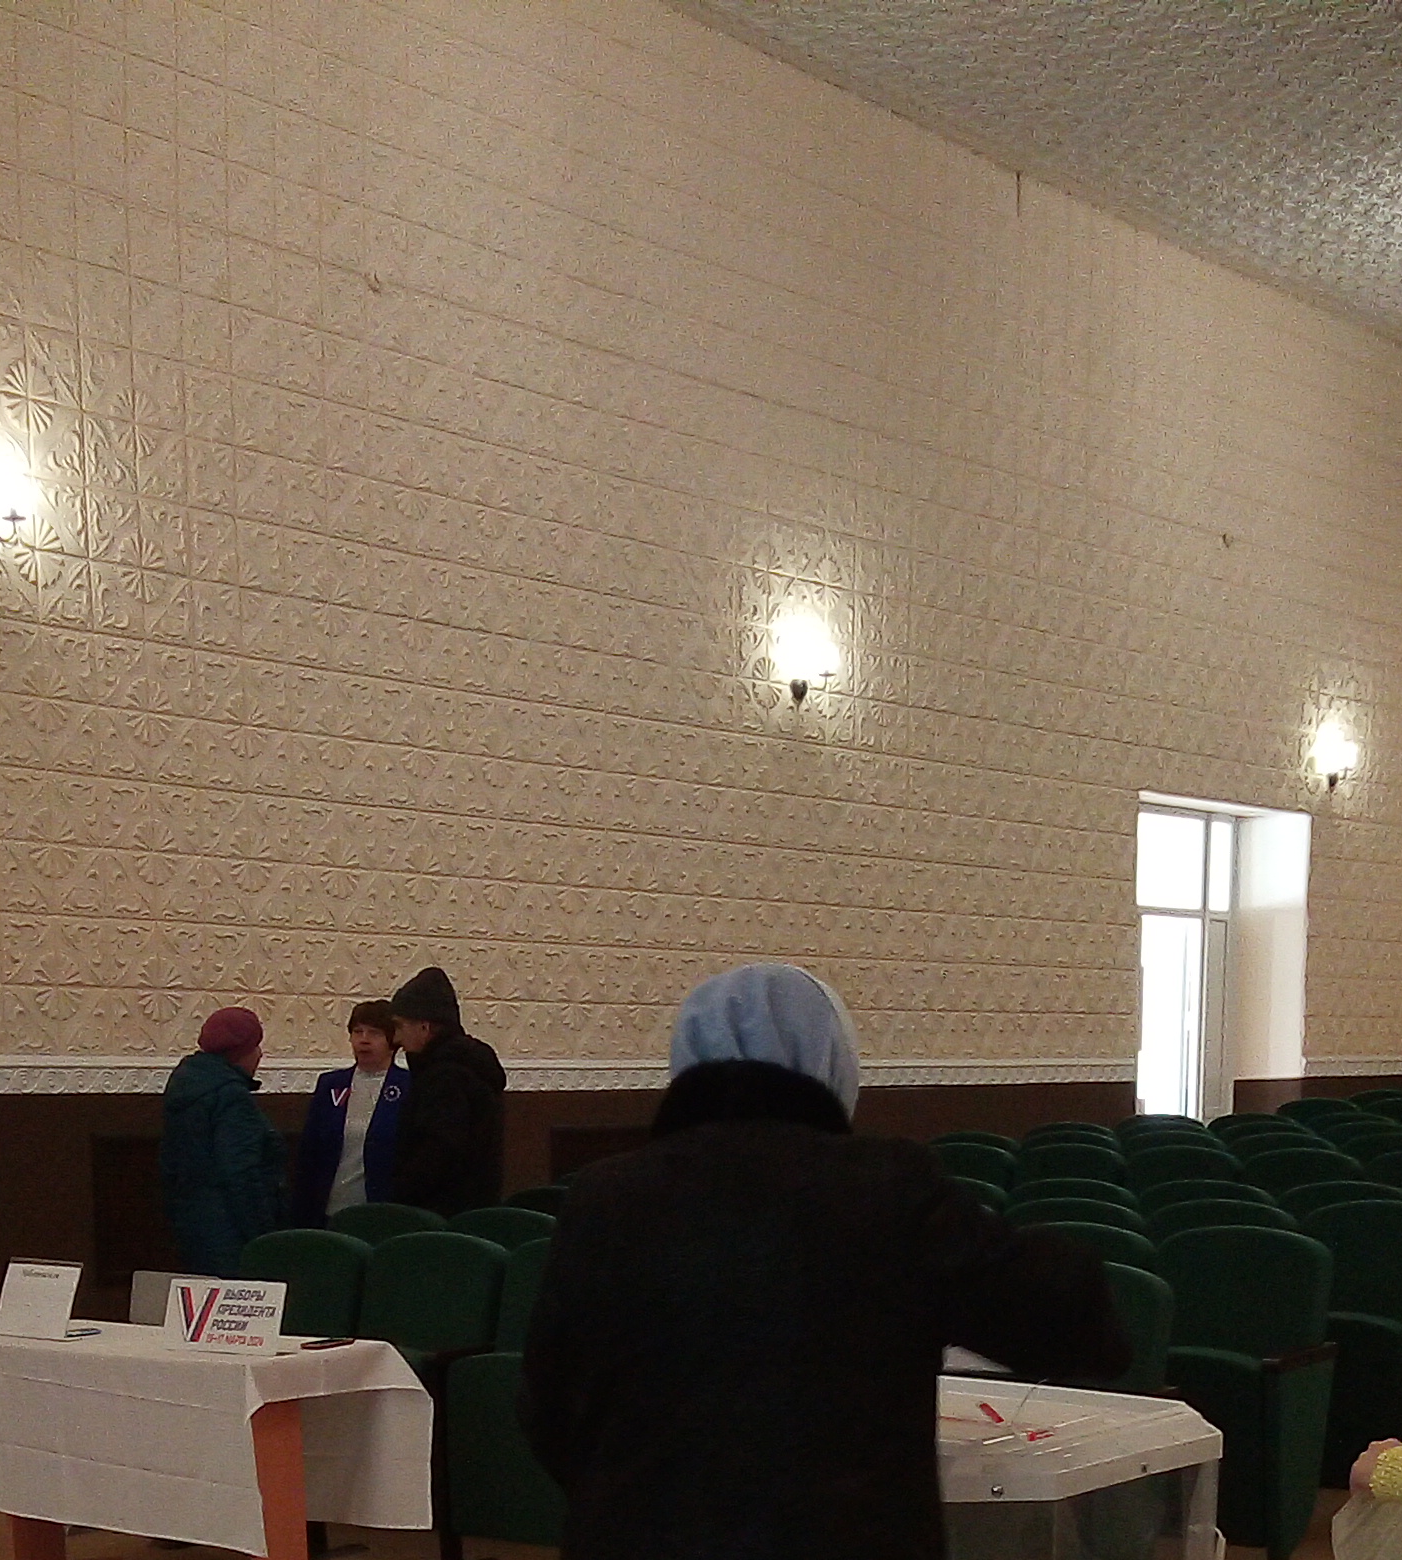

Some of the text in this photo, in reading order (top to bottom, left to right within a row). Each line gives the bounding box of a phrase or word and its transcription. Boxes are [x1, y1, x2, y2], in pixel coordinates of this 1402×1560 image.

[223, 1287, 266, 1301] ВЫБОРЫ
[217, 1303, 277, 1318] ПРЕЗИДЕНТА
[211, 1319, 249, 1331] РОССИИ
